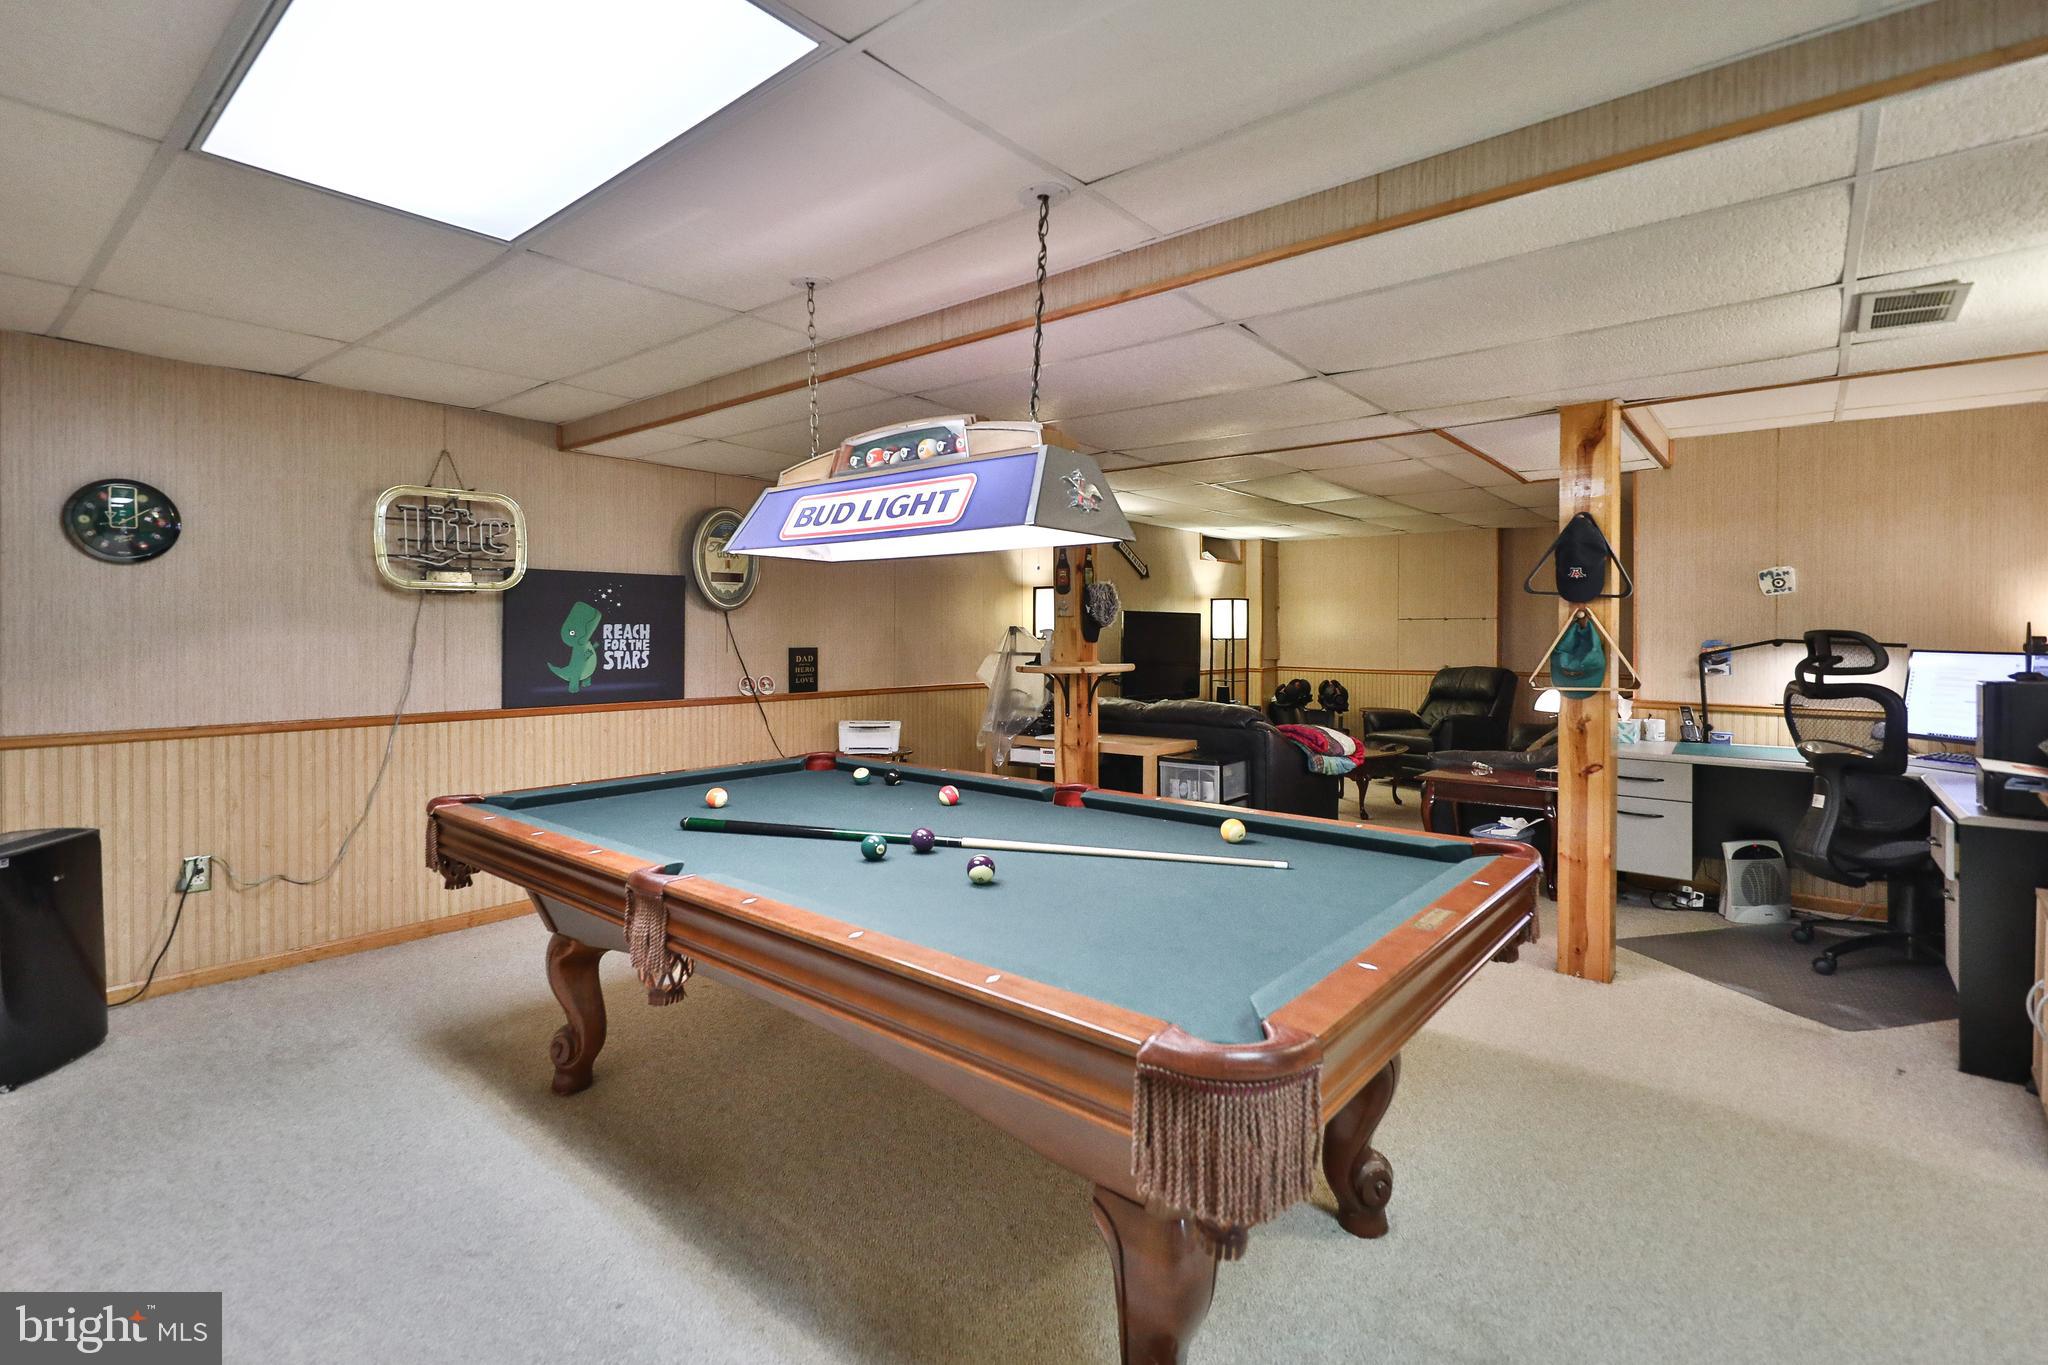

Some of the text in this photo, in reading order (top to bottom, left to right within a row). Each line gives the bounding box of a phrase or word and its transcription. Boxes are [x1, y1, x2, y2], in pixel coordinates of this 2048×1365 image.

[793, 489, 960, 528] BUD LIGHT
[602, 623, 651, 640] REACH
[604, 639, 650, 651] FOR THE
[603, 650, 650, 670] STARS
[795, 655, 814, 663] DAD
